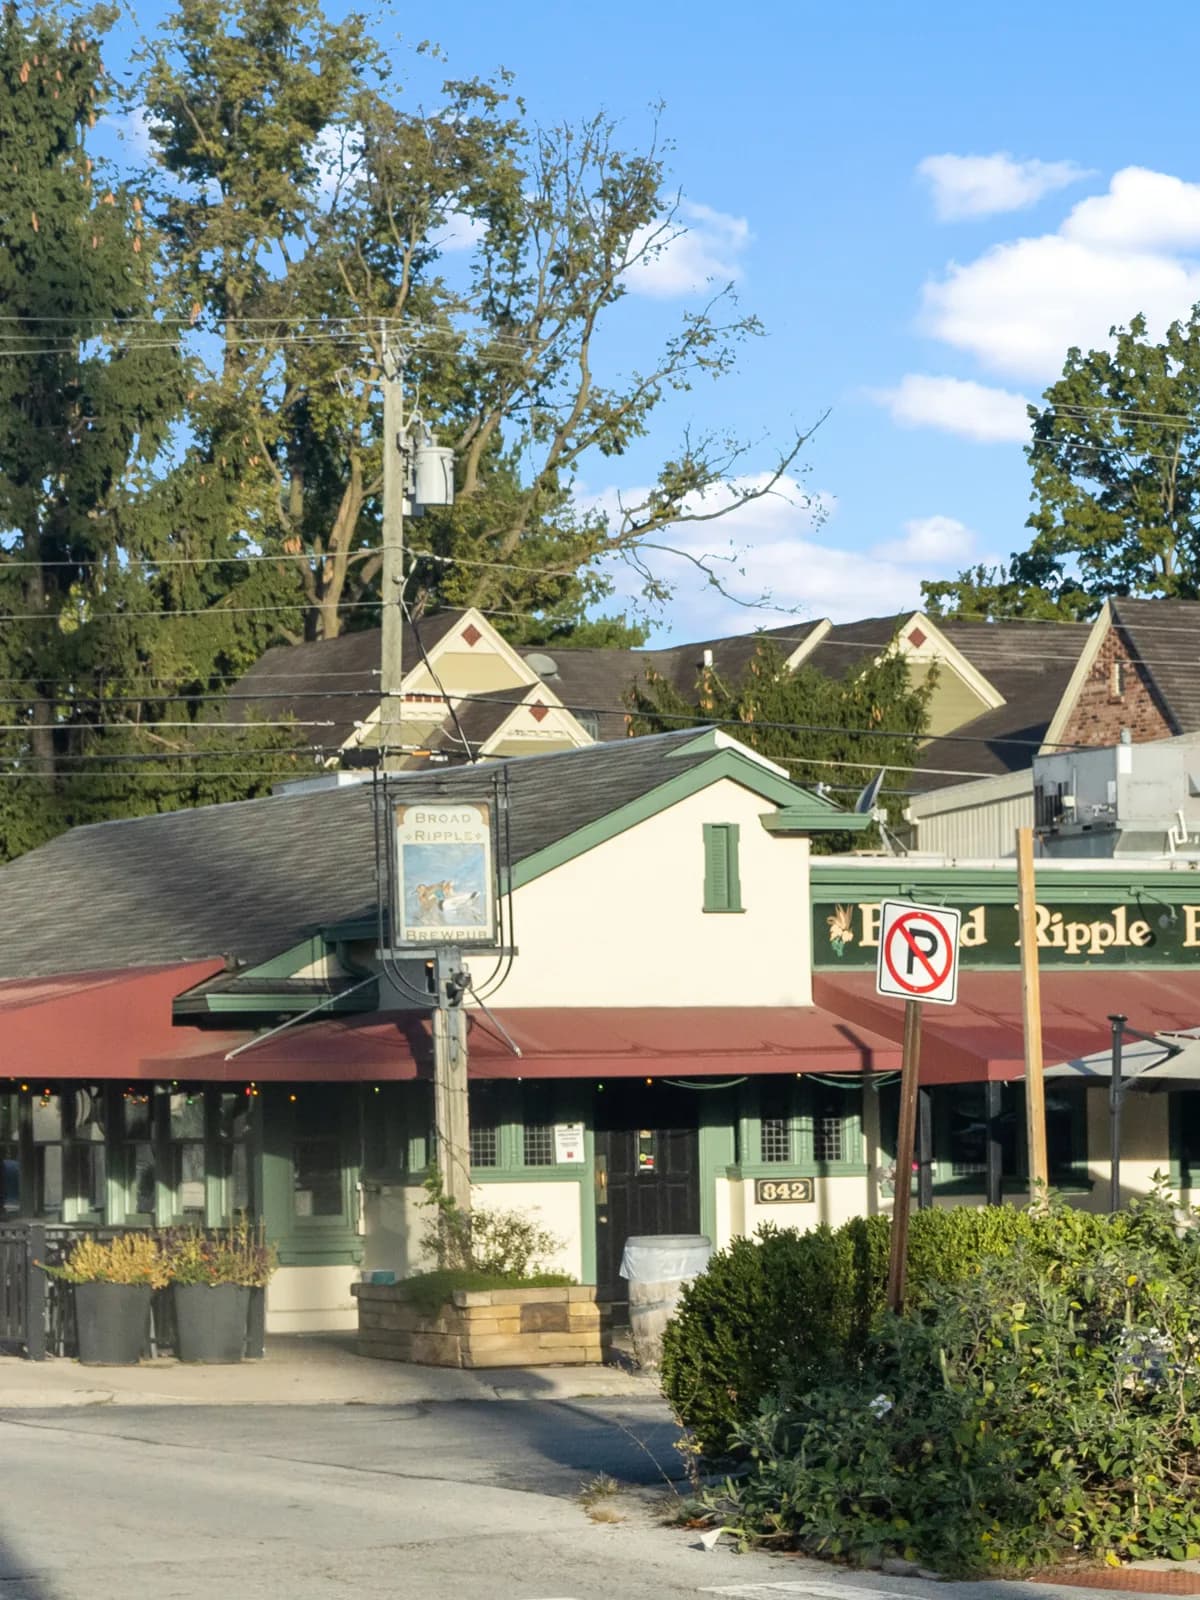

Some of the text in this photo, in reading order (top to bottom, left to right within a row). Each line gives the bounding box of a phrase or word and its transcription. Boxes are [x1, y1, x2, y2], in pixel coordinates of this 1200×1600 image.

[415, 812, 472, 824] BROAD
[414, 831, 474, 841] RIPPLE
[1014, 904, 1152, 954] Ripple
[406, 930, 488, 941] BREWPUB
[763, 1183, 806, 1200] 842
